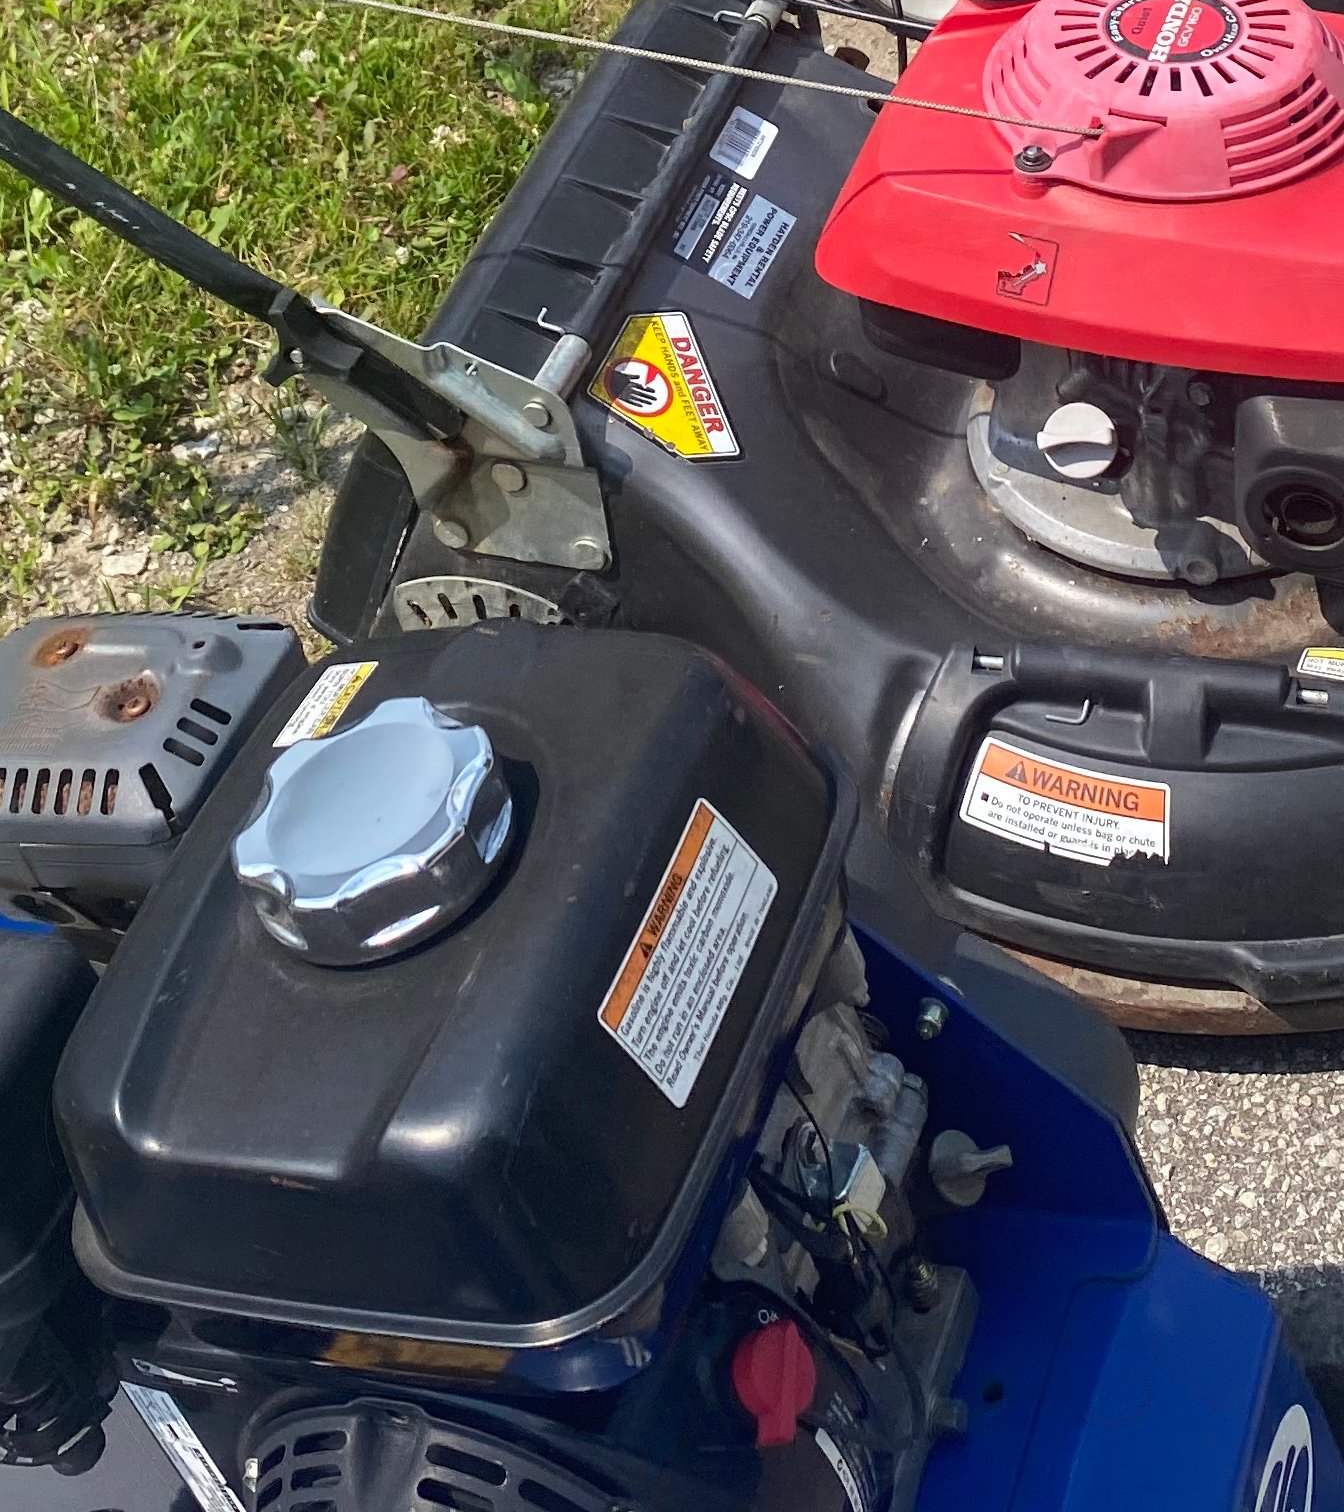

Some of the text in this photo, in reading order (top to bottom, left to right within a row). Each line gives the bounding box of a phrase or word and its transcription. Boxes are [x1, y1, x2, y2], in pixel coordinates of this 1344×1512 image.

[1176, 5, 1203, 48] GCV160
[713, 220, 729, 240] BLADE
[731, 186, 747, 207] MEETS
[700, 238, 719, 262] SAFETY
[725, 206, 777, 286] POWER EQUIPMENT
[744, 221, 789, 288] HAYDEN RENTAL
[755, 245, 763, 253] &
[649, 319, 709, 453] KEEP HANDS and FEET AWAY
[670, 331, 725, 436] DANGER
[990, 796, 1156, 848] Do not operate unless bag or chute
[1017, 793, 1030, 805] TO
[1033, 798, 1079, 818] PREVENT
[1030, 766, 1140, 812] WARNING
[987, 810, 1002, 821] are
[1004, 814, 1046, 835] installed
[1047, 830, 1058, 839] or
[1101, 843, 1111, 852] in
[646, 869, 683, 939] WARNING
[619, 991, 644, 1037] Gasoline
[639, 980, 649, 994] is
[644, 949, 664, 983] highly
[658, 897, 688, 953] flammable
[683, 877, 698, 901] and
[630, 1022, 647, 1049] Turn
[641, 987, 663, 1026] engine
[657, 970, 671, 991] off
[664, 950, 680, 975] and
[673, 936, 686, 956] let
[680, 916, 696, 940] cool
[690, 883, 711, 919] before
[643, 1039, 657, 1062] The
[652, 1004, 674, 1042] engine
[668, 975, 687, 1008] emits
[681, 950, 699, 979] toxic
[692, 915, 715, 954] carbon
[653, 1056, 666, 1076] Do
[660, 1037, 675, 1060] not
[669, 1019, 683, 1041] run
[678, 1007, 688, 1022] in
[683, 993, 695, 1011] an
[690, 947, 716, 996] enclosed
[665, 1058, 683, 1089] Read
[677, 1020, 700, 1061] Owner's
[694, 984, 716, 1024] Manual
[710, 953, 730, 988] before
